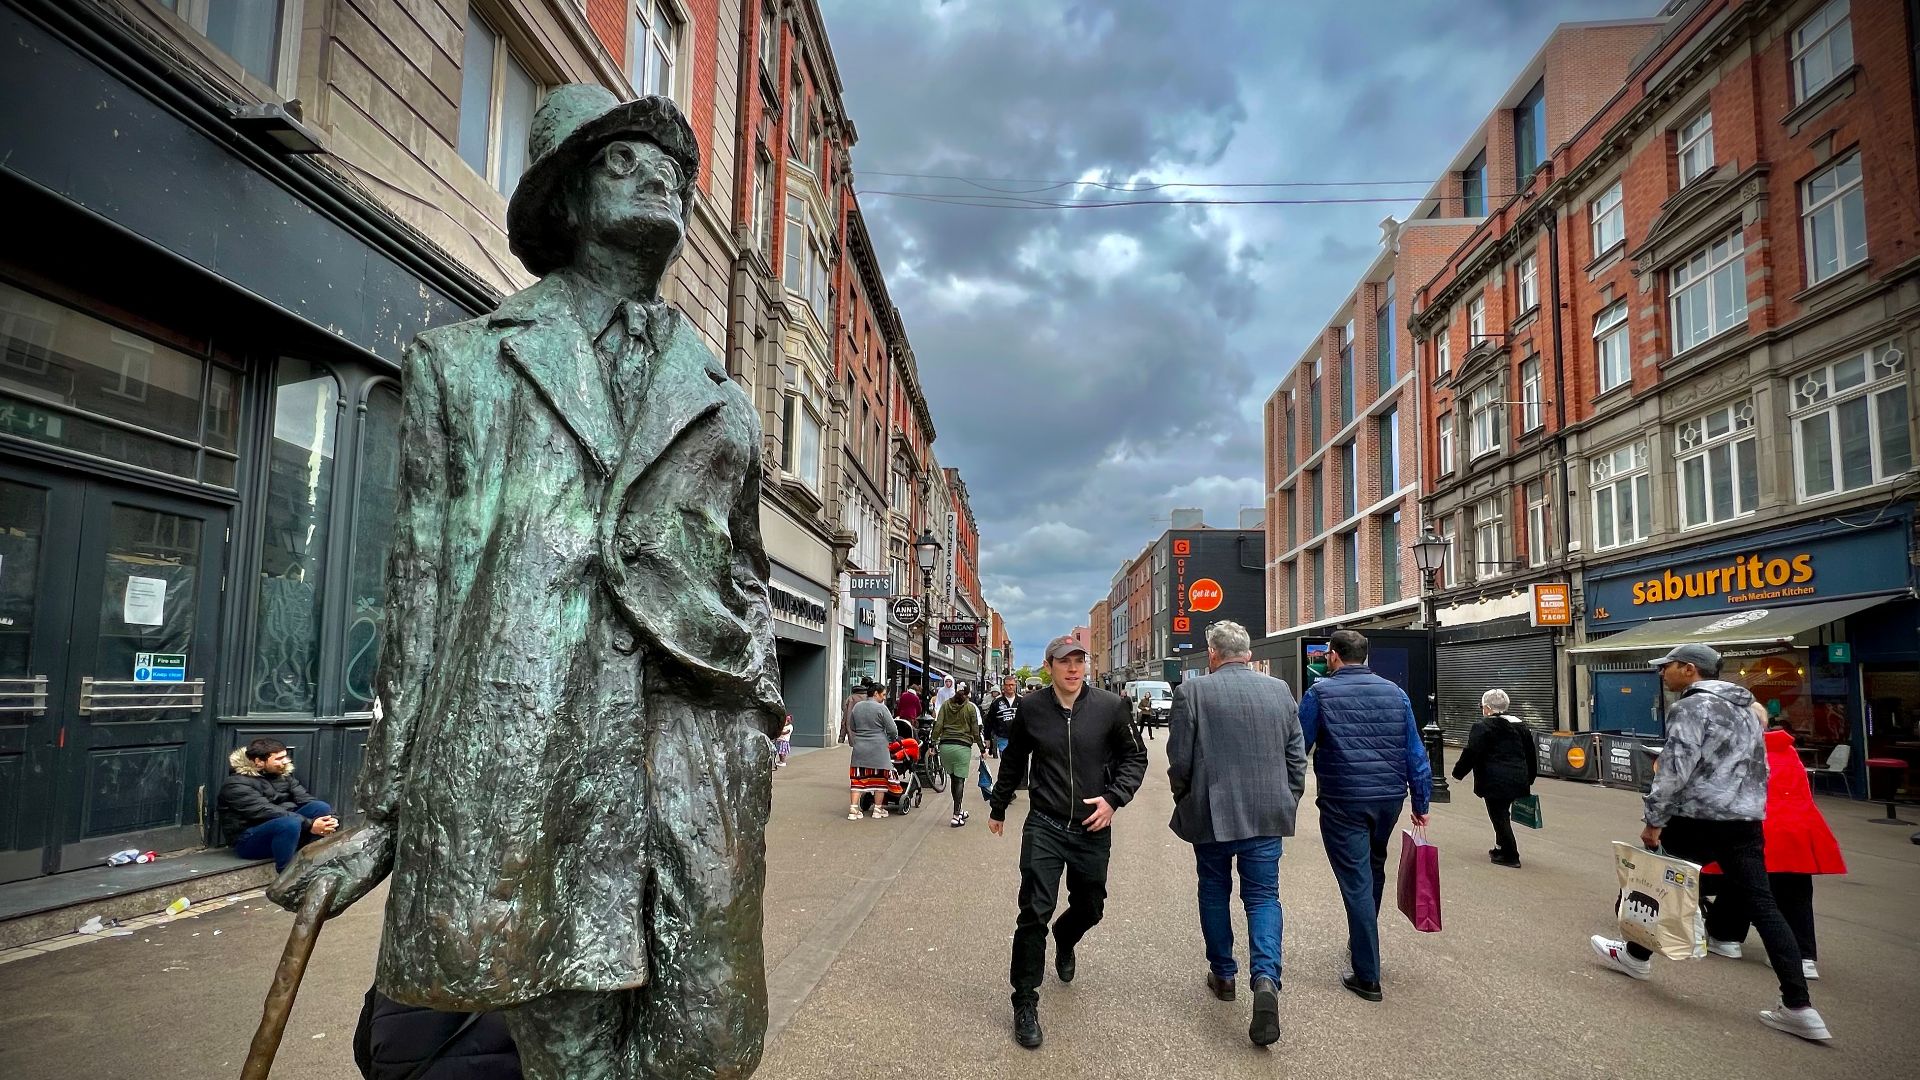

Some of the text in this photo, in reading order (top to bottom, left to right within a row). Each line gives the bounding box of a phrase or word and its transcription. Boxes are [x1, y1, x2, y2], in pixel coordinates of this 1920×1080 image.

[1177, 542, 1186, 552] G
[851, 577, 889, 589] DUFFY'S
[1632, 554, 1814, 605] saburritos
[1192, 589, 1204, 600] Get
[1727, 586, 1815, 603] Fresh Mexican Kitchen
[1177, 619, 1186, 629] G
[1611, 771, 1633, 782] TACOS
